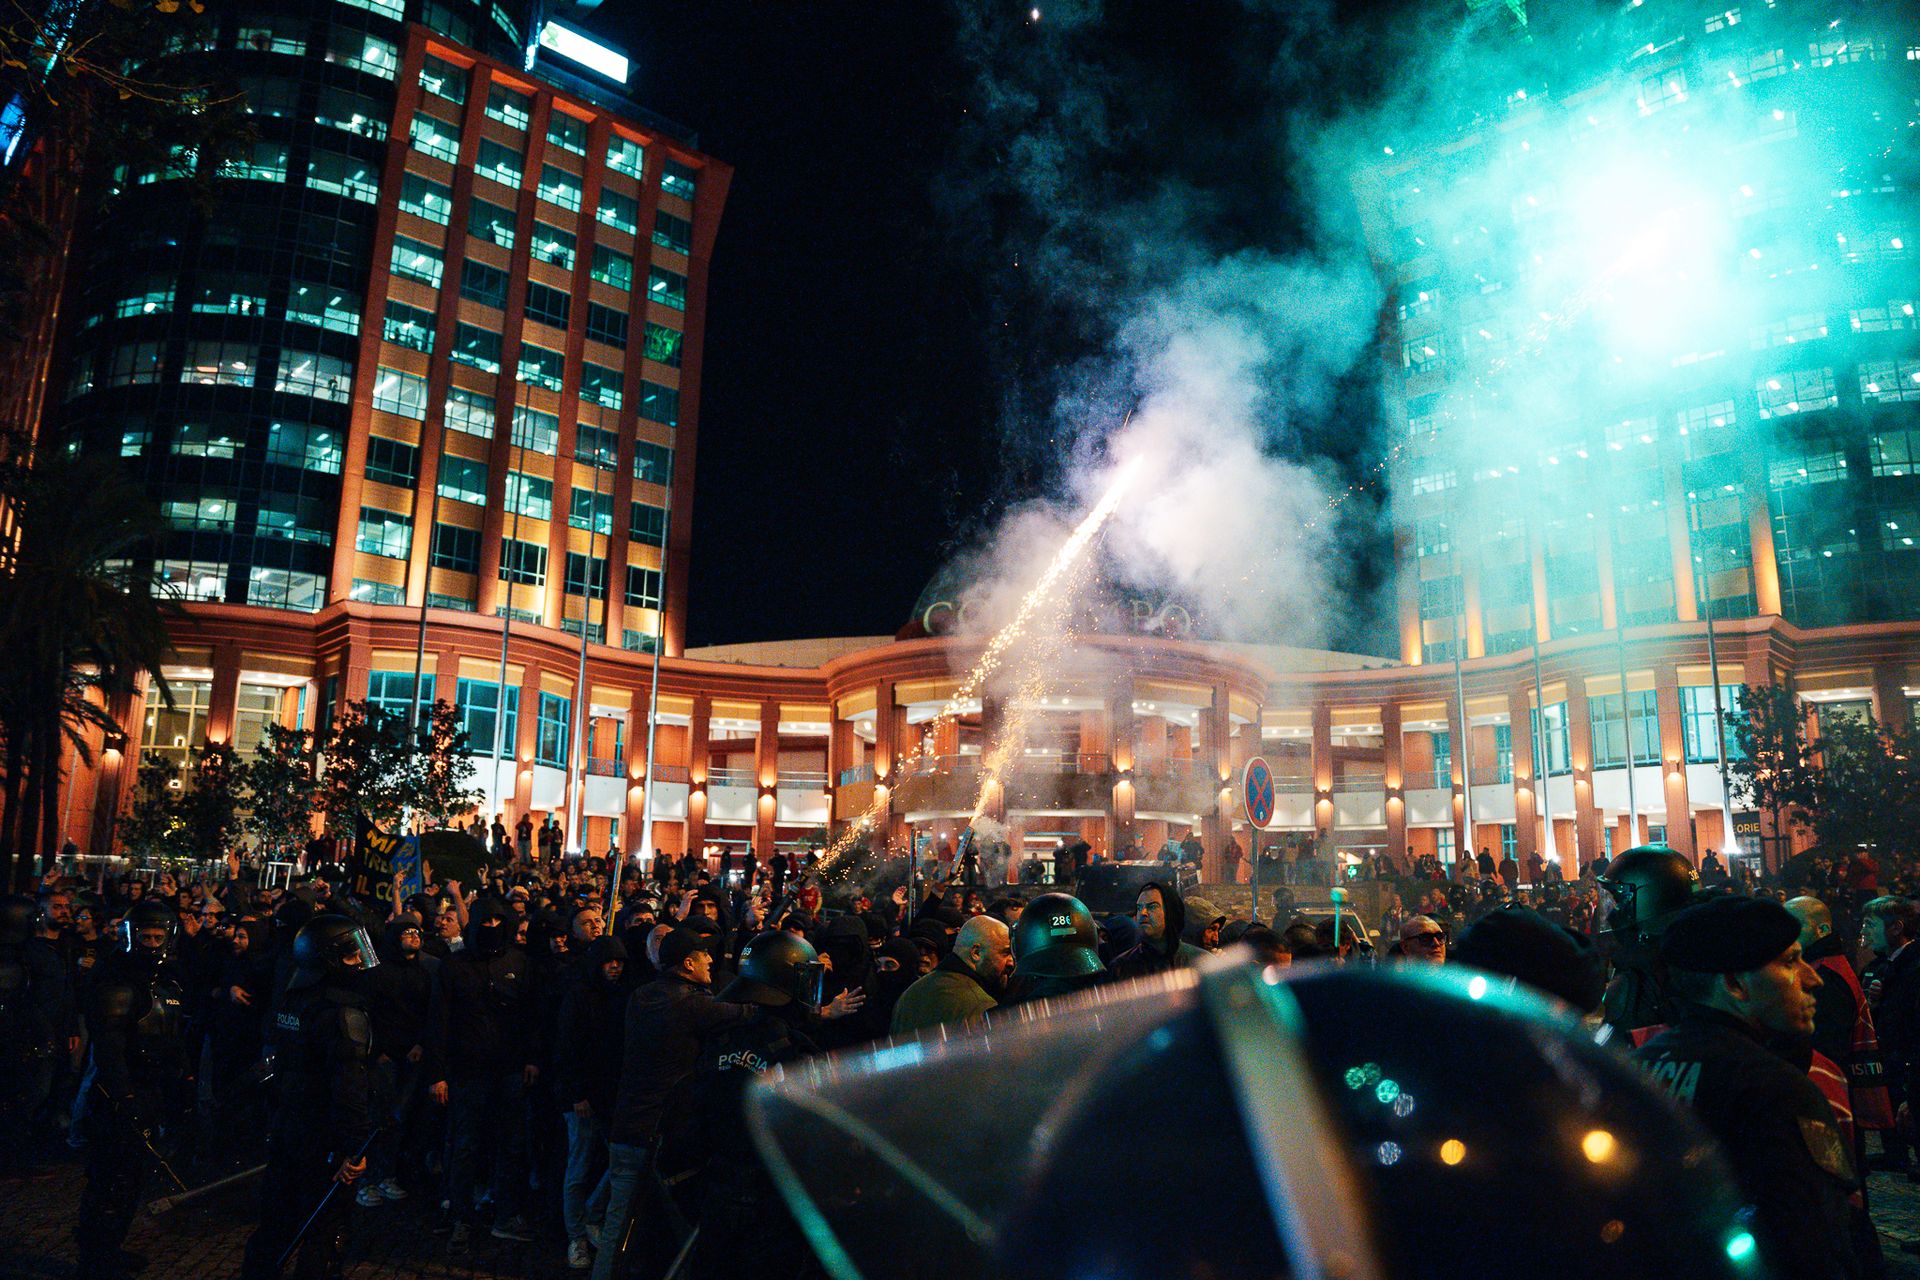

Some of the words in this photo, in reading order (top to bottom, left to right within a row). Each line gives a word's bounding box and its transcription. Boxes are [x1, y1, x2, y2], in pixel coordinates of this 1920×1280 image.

[366, 829, 397, 854] MI
[1052, 915, 1072, 927] 286
[276, 1012, 300, 1027] POLÍCIA
